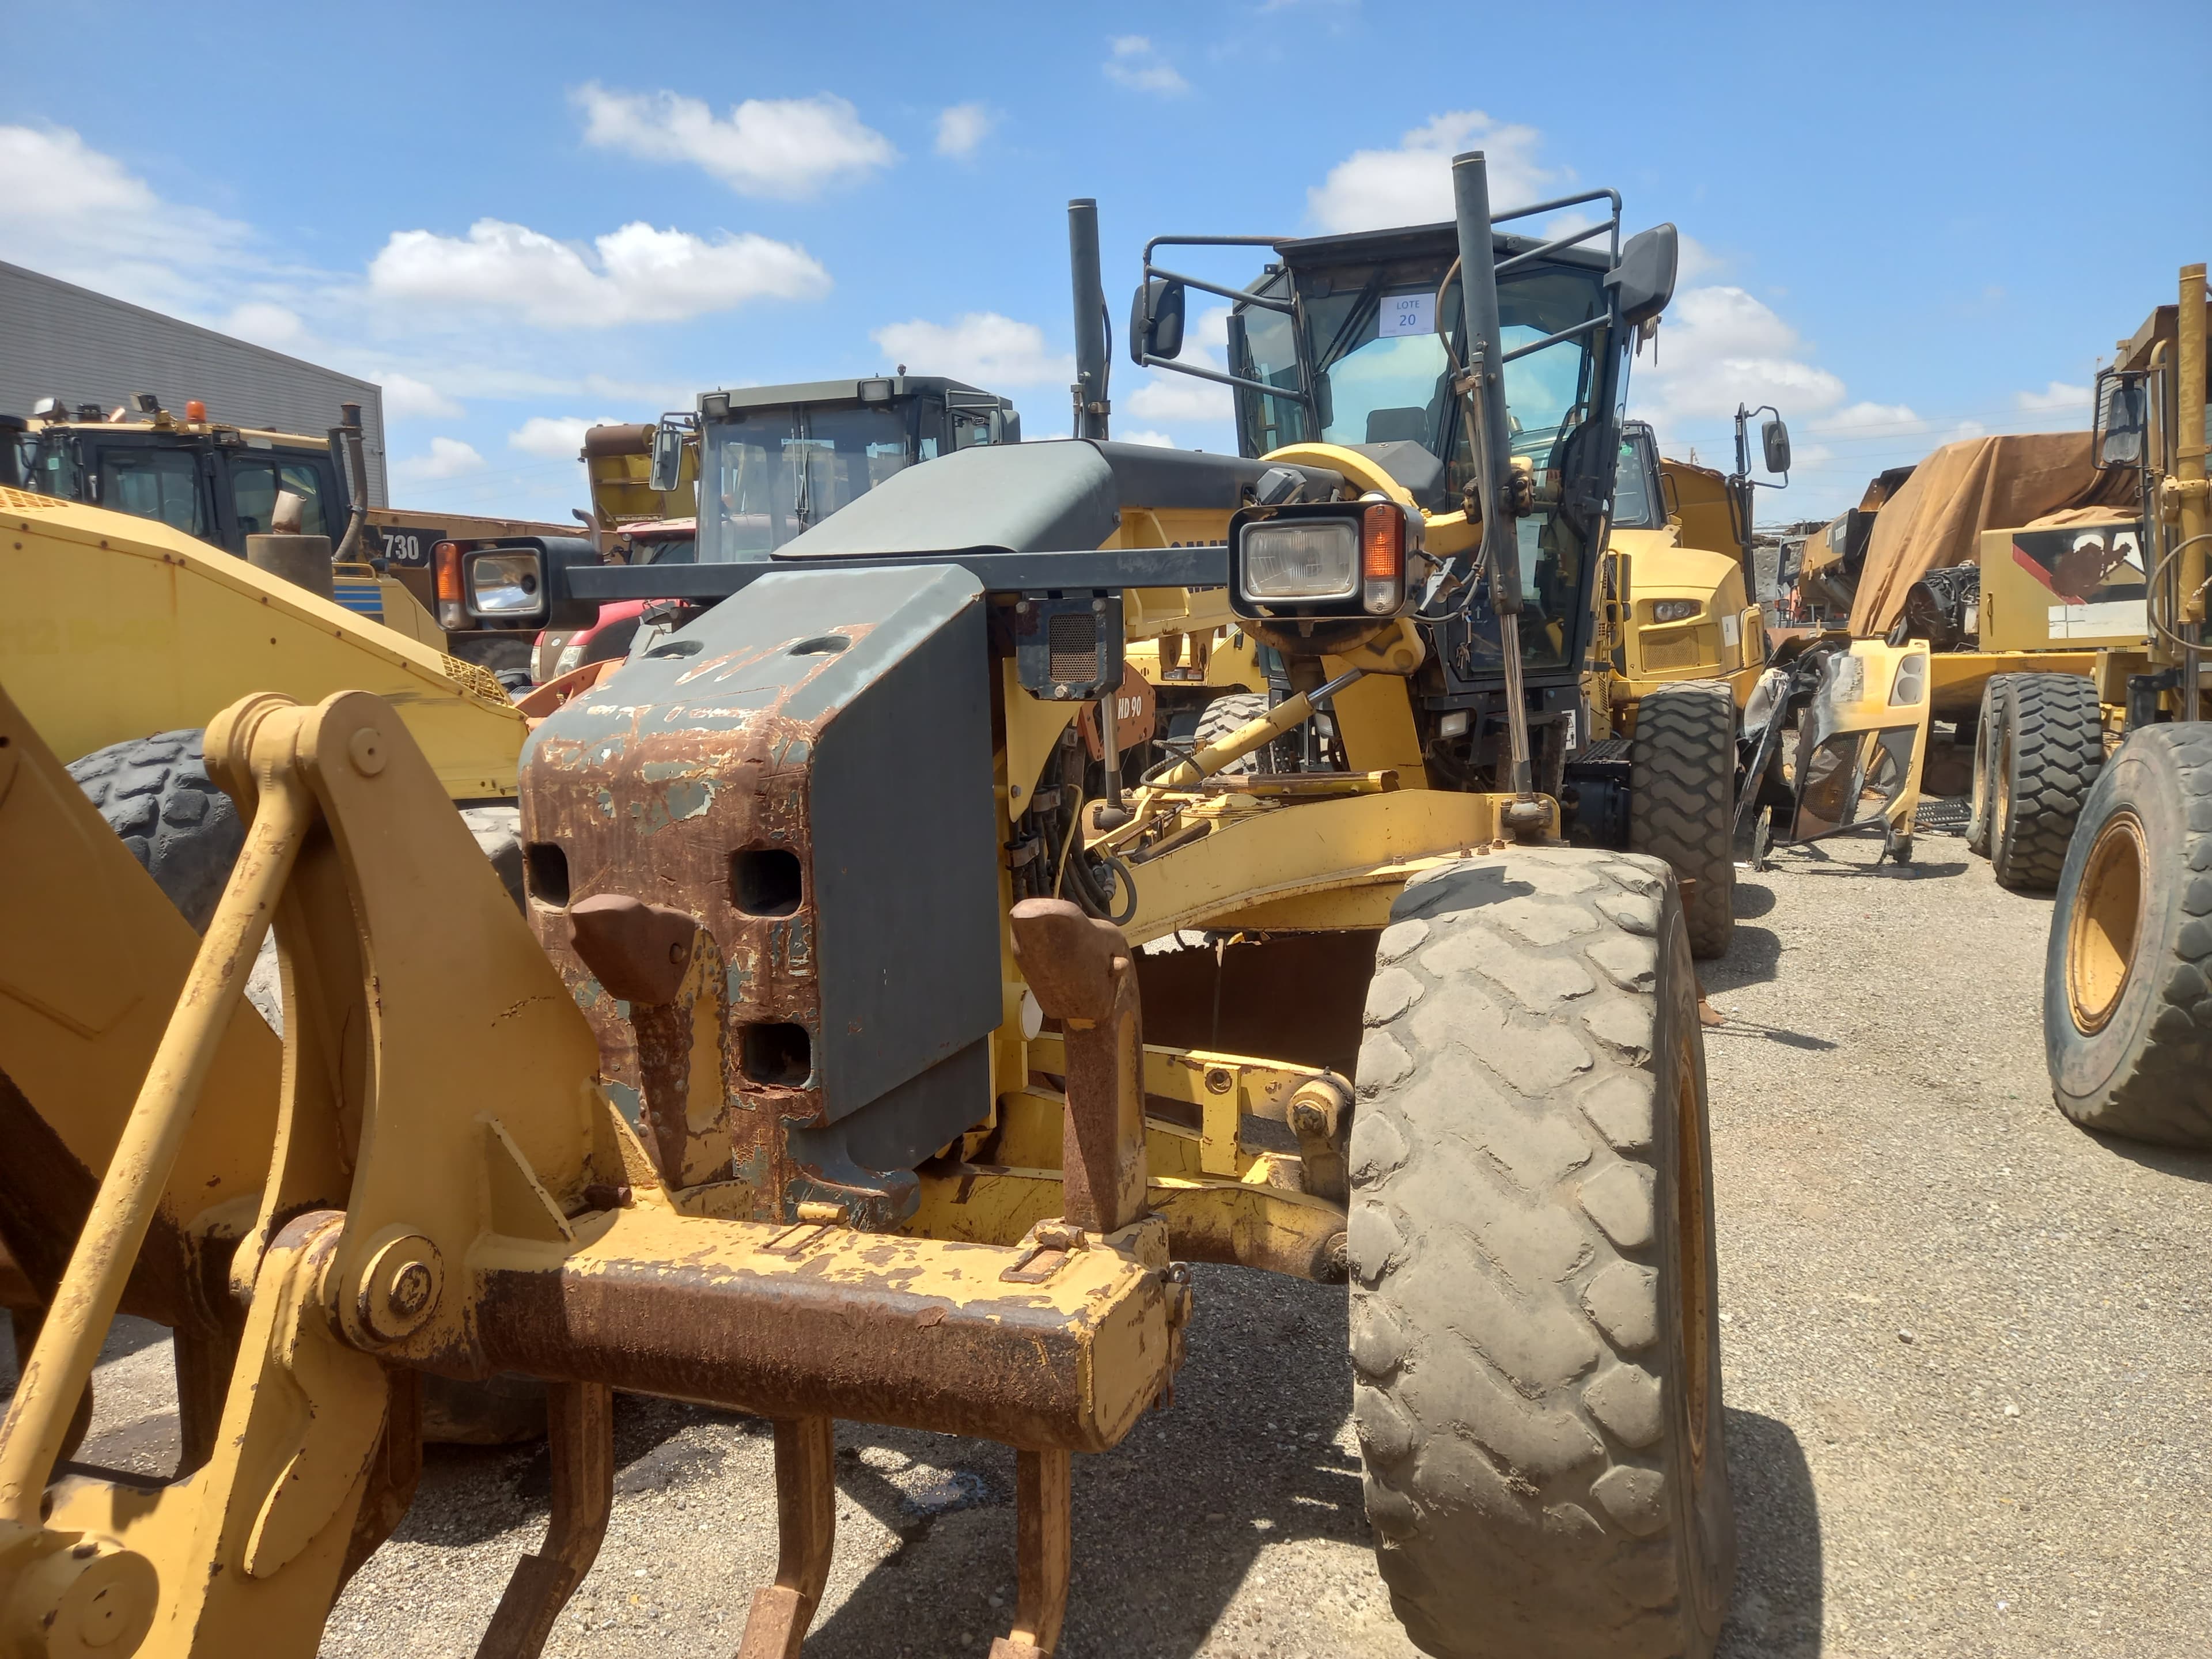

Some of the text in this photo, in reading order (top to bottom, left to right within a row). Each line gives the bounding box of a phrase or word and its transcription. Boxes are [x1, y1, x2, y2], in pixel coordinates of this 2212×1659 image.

[1396, 300, 1420, 310] LOTE
[1399, 314, 1416, 327] 20
[382, 534, 419, 560] 730
[1118, 695, 1142, 720] HD 90
